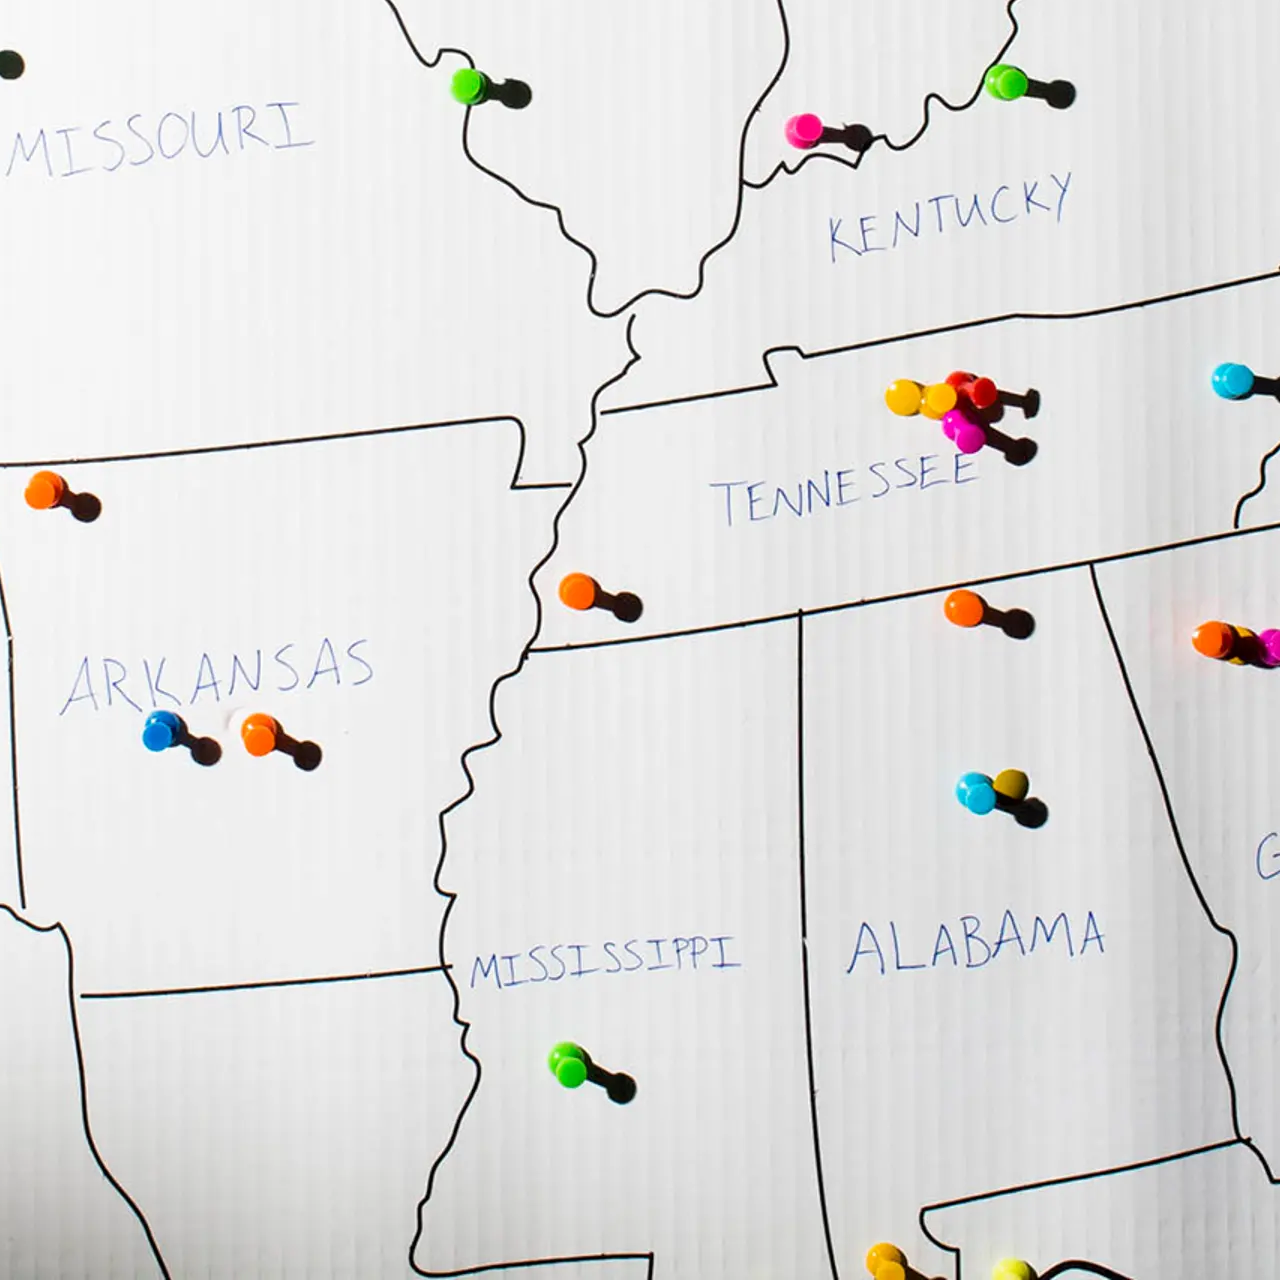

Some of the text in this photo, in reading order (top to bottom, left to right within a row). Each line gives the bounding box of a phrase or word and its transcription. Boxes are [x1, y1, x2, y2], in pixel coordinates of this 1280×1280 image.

[6, 100, 317, 177] MISSOURI
[828, 171, 1072, 263] KENTUCKY
[709, 451, 980, 528] TENNESSEE
[59, 637, 375, 716] ARKANSAS
[470, 935, 743, 990] MISSISSIPPI
[846, 908, 1107, 976] ALABAMA
